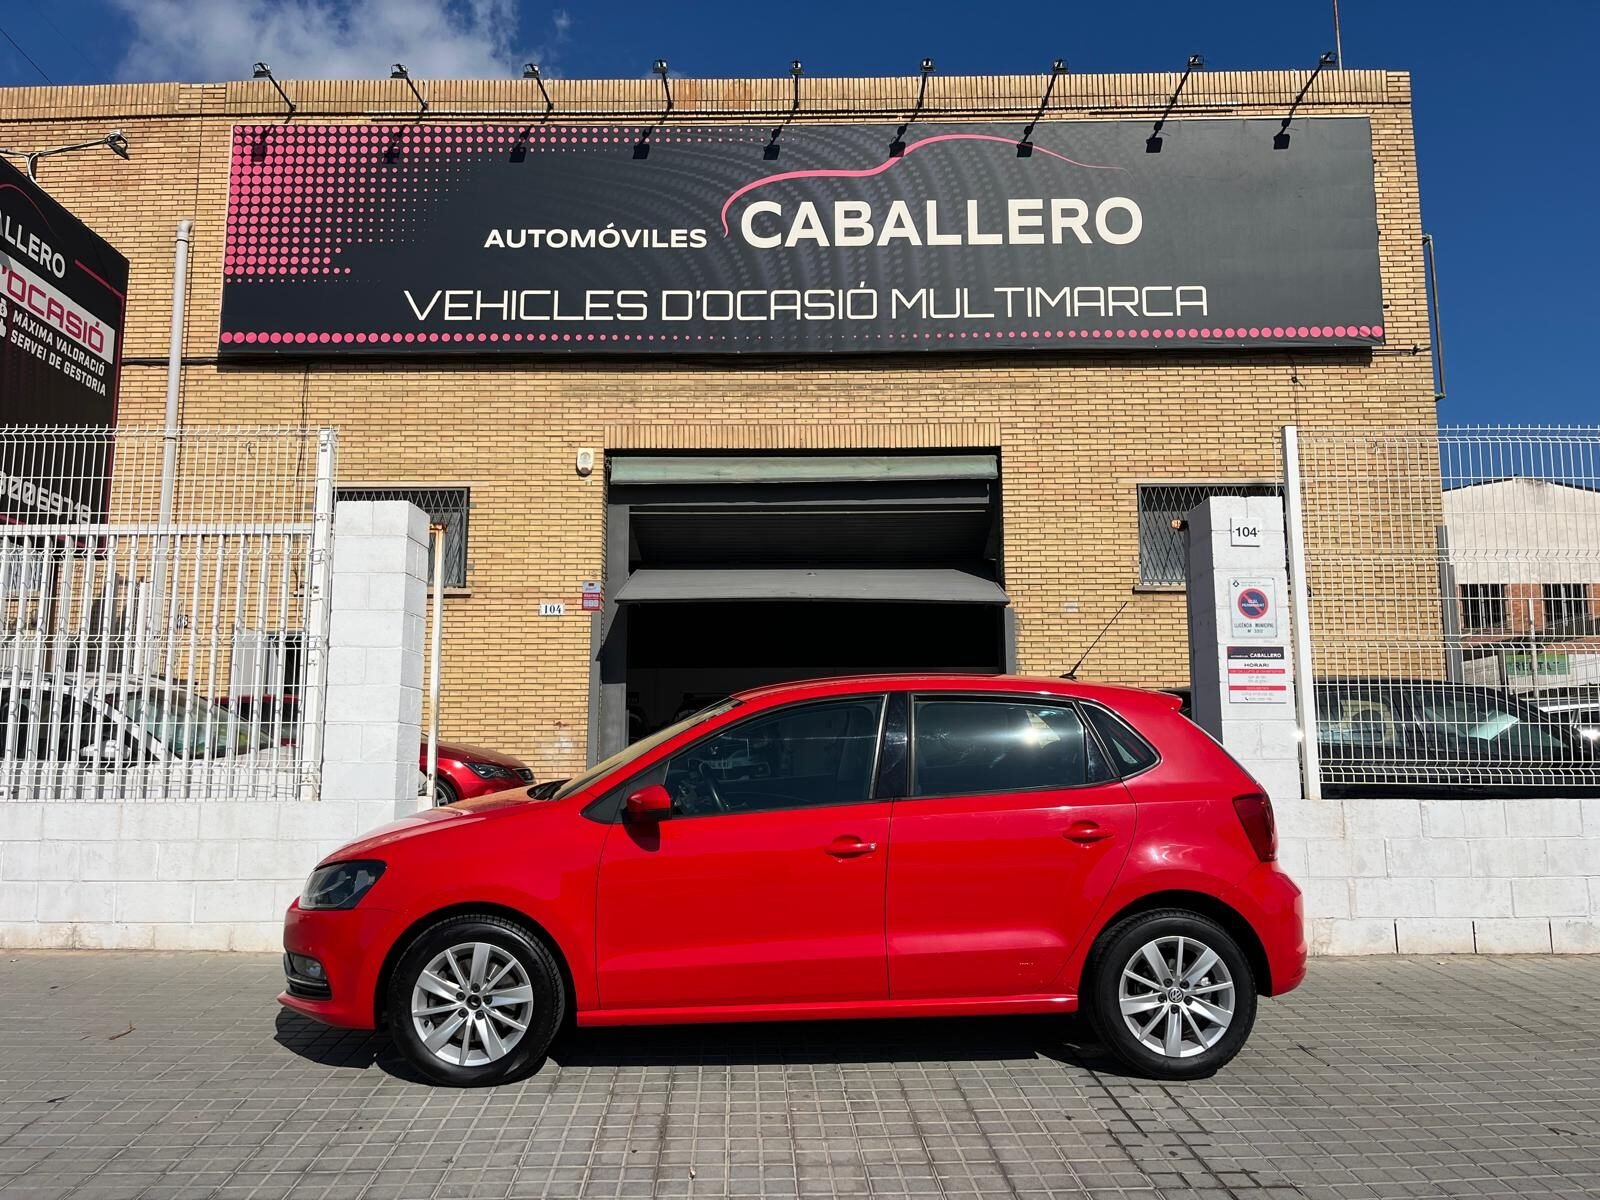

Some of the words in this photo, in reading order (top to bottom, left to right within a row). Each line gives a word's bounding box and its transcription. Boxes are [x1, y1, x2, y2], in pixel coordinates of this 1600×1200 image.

[484, 222, 708, 249] AUTOMÓVILES
[737, 196, 1143, 249] CABALLERO
[403, 289, 648, 321] VEHICLES
[661, 280, 878, 321] D'OCASIÓ
[891, 285, 1208, 320] MULTIMARCA
[10, 329, 47, 361] SERVEI
[48, 352, 62, 370] DE
[63, 361, 106, 397] GESTORIA
[12, 310, 53, 346] MÀXIMA
[56, 336, 105, 377] VALORACIÓ
[544, 604, 562, 614] 104
